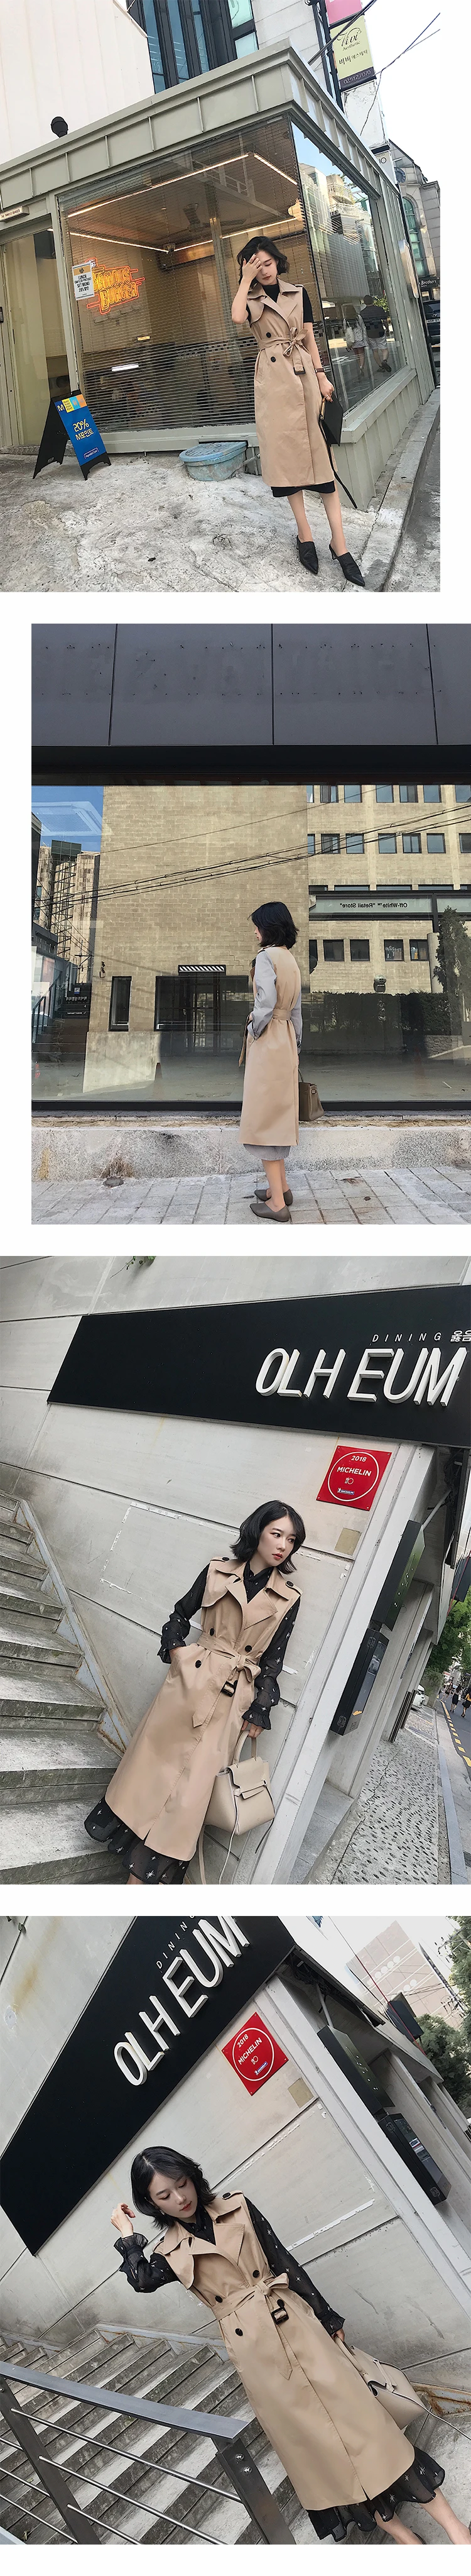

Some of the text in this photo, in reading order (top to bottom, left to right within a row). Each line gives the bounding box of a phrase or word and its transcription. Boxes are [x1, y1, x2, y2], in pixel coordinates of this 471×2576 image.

[92, 267, 131, 292] FAMOUS
[100, 282, 138, 311] BURGER
[72, 419, 89, 432] 20%
[75, 428, 94, 441] M포인트
[372, 1332, 442, 1343] DINING
[256, 1347, 468, 1407] OLH EUM
[337, 1467, 372, 1477] MICHELIN
[114, 1995, 181, 2086] OLH
[237, 2034, 249, 2048] 2018
[238, 2037, 263, 2065] MICHELIN
